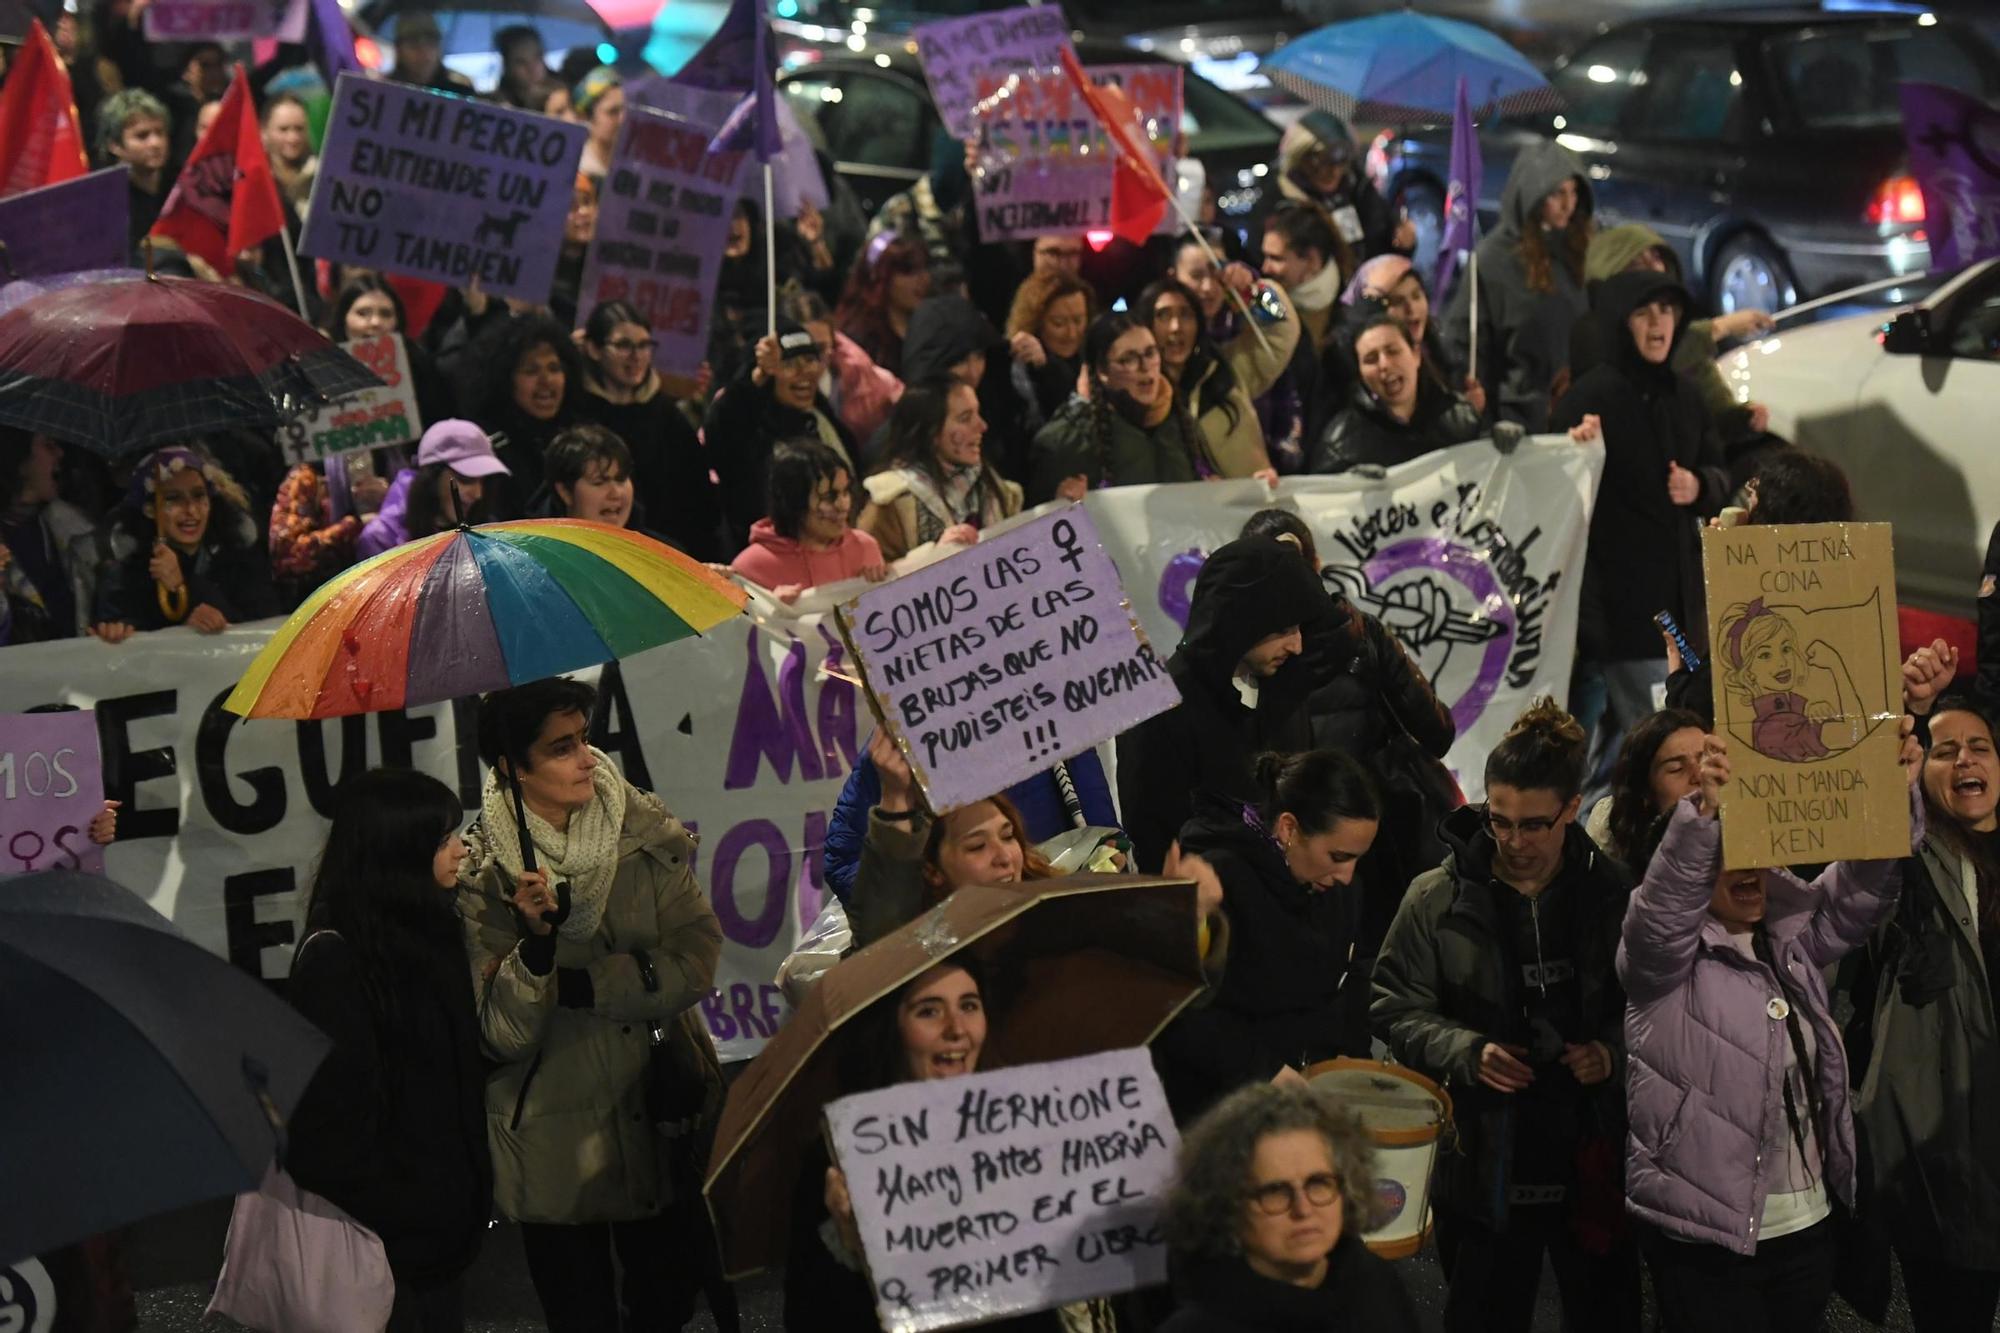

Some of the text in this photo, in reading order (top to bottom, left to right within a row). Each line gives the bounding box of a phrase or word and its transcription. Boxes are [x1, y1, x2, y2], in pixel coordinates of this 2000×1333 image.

[347, 90, 567, 167] SI MI PERRO
[351, 137, 547, 209] ENTIENDE UN
[336, 220, 523, 286] TU TAMBIEN
[1726, 538, 1856, 566] NA MIÑA
[1759, 570, 1823, 593] CONA
[864, 547, 1041, 653] SOMOS LAS
[986, 602, 1024, 637] DE
[1031, 580, 1095, 617] LAS
[899, 614, 1099, 728] BRUJAS QUE NO
[1063, 642, 1168, 713] QUEMAR
[1023, 719, 1061, 763] !!!
[1739, 768, 1868, 800] NON MANDA
[1766, 798, 1848, 824] NINGÚN
[1770, 829, 1825, 856] KEN
[885, 1177, 1145, 1253] MUERTO EN EL
